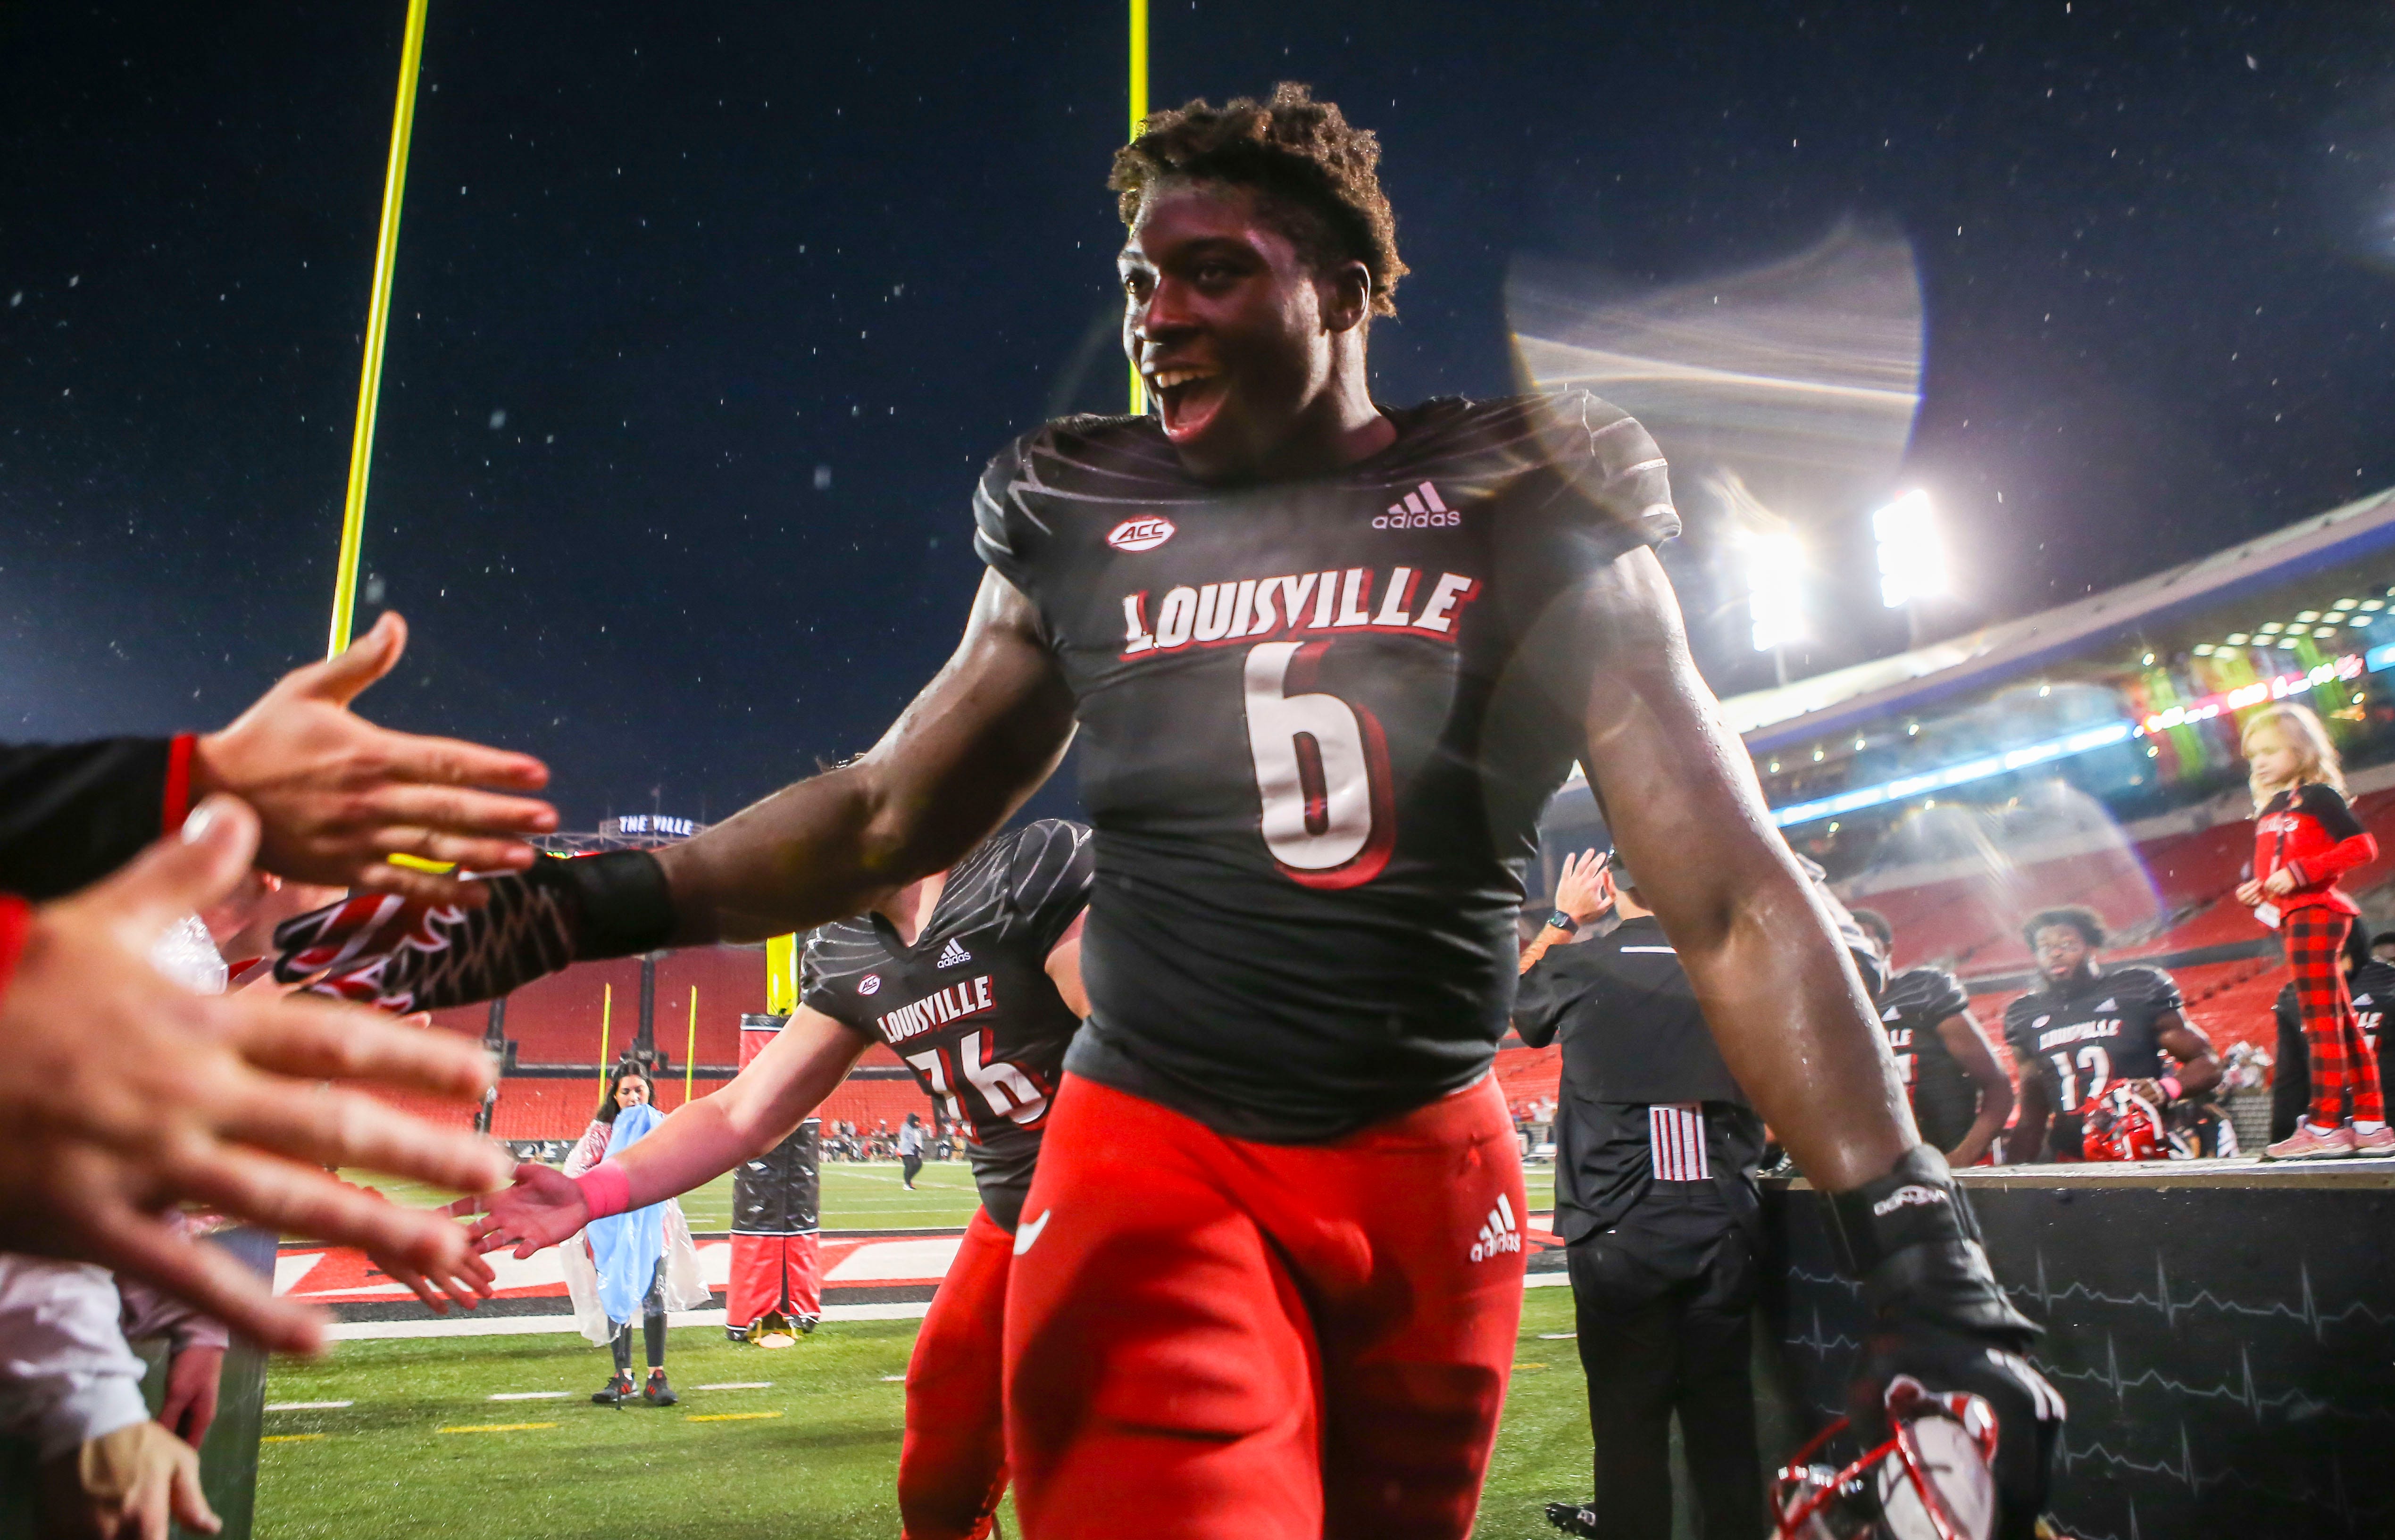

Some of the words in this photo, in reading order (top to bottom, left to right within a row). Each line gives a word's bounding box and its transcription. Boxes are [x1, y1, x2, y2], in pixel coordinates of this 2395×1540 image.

[1117, 522, 1165, 541] ACC
[1371, 510, 1460, 529] adidas
[1121, 567, 1474, 656] LOUISVILLE
[1244, 641, 1372, 869] 6
[618, 815, 649, 833] THE
[653, 815, 693, 836] VILLE
[937, 952, 971, 968] adidas
[876, 975, 993, 1044] LOUISVILLE
[906, 1030, 1047, 1138] 76
[1470, 1230, 1521, 1263] adidas
